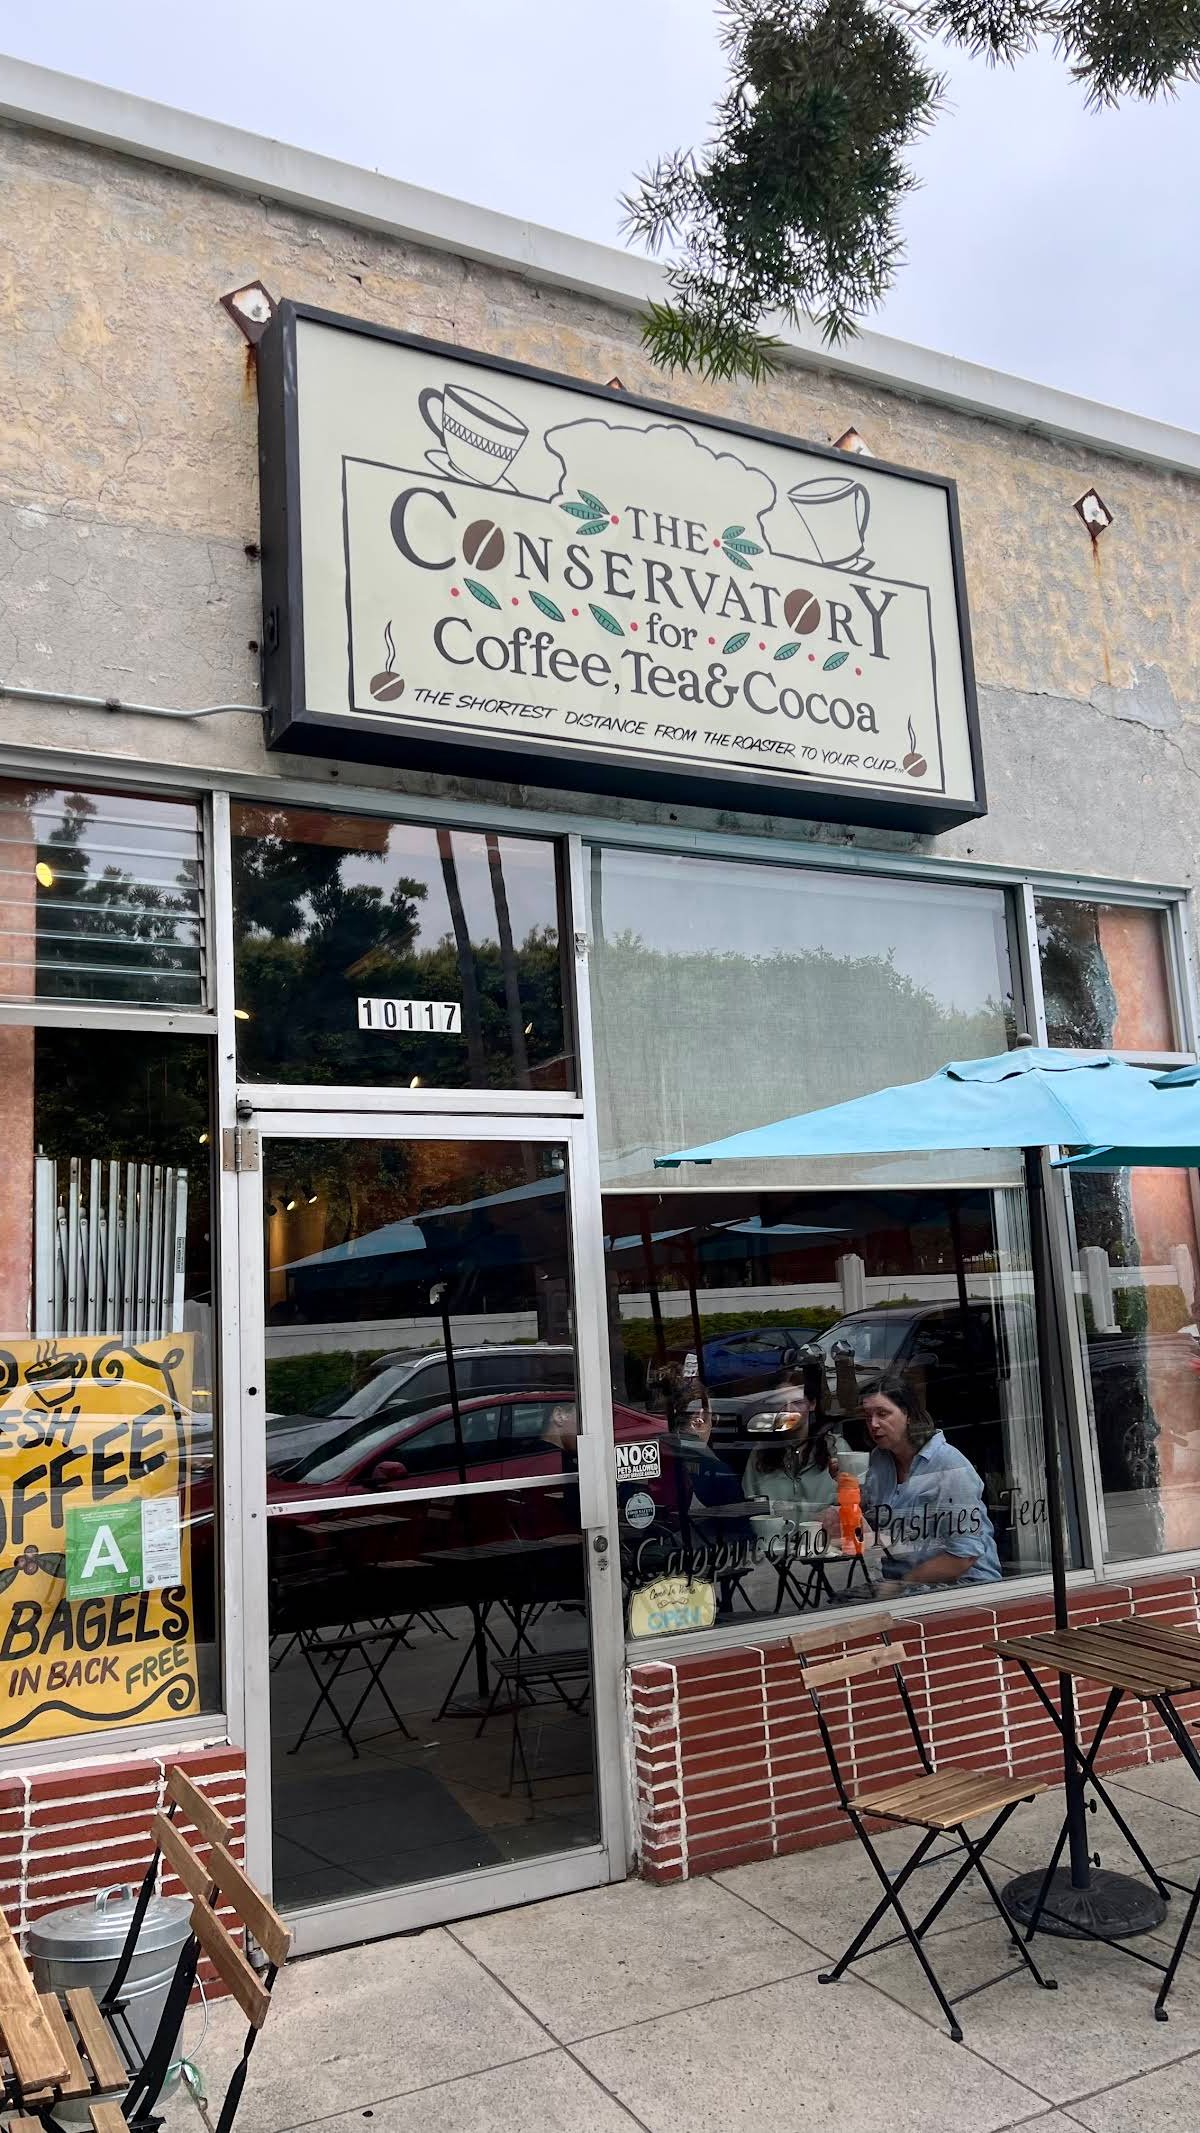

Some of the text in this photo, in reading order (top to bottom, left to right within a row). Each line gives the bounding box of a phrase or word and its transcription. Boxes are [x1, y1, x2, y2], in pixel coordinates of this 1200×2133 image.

[625, 506, 709, 556] THE
[390, 487, 898, 660] CONSERVATORY
[646, 612, 698, 651] for
[414, 688, 454, 706] THE
[456, 695, 558, 719] SHORTEST
[564, 711, 648, 735] DISTANCE
[654, 724, 697, 743] FROM
[704, 731, 730, 747] THE
[731, 735, 796, 758] ROASTER
[799, 745, 817, 760] TO
[822, 749, 860, 767] YOUR
[743, 670, 880, 734] Cocoa
[362, 1000, 456, 1030] 10117
[0, 1404, 167, 1555] FFEE
[616, 1445, 641, 1468] NO
[617, 1463, 658, 1475] PETS ALLOWED
[81, 1525, 128, 1578] A
[637, 1487, 1048, 1587] Cappuccino Pastries Tea
[0, 1585, 190, 1661] BAGELS
[647, 1605, 701, 1631] OPEN
[8, 1655, 120, 1698] IN BACK
[125, 1638, 190, 1694] FREE
